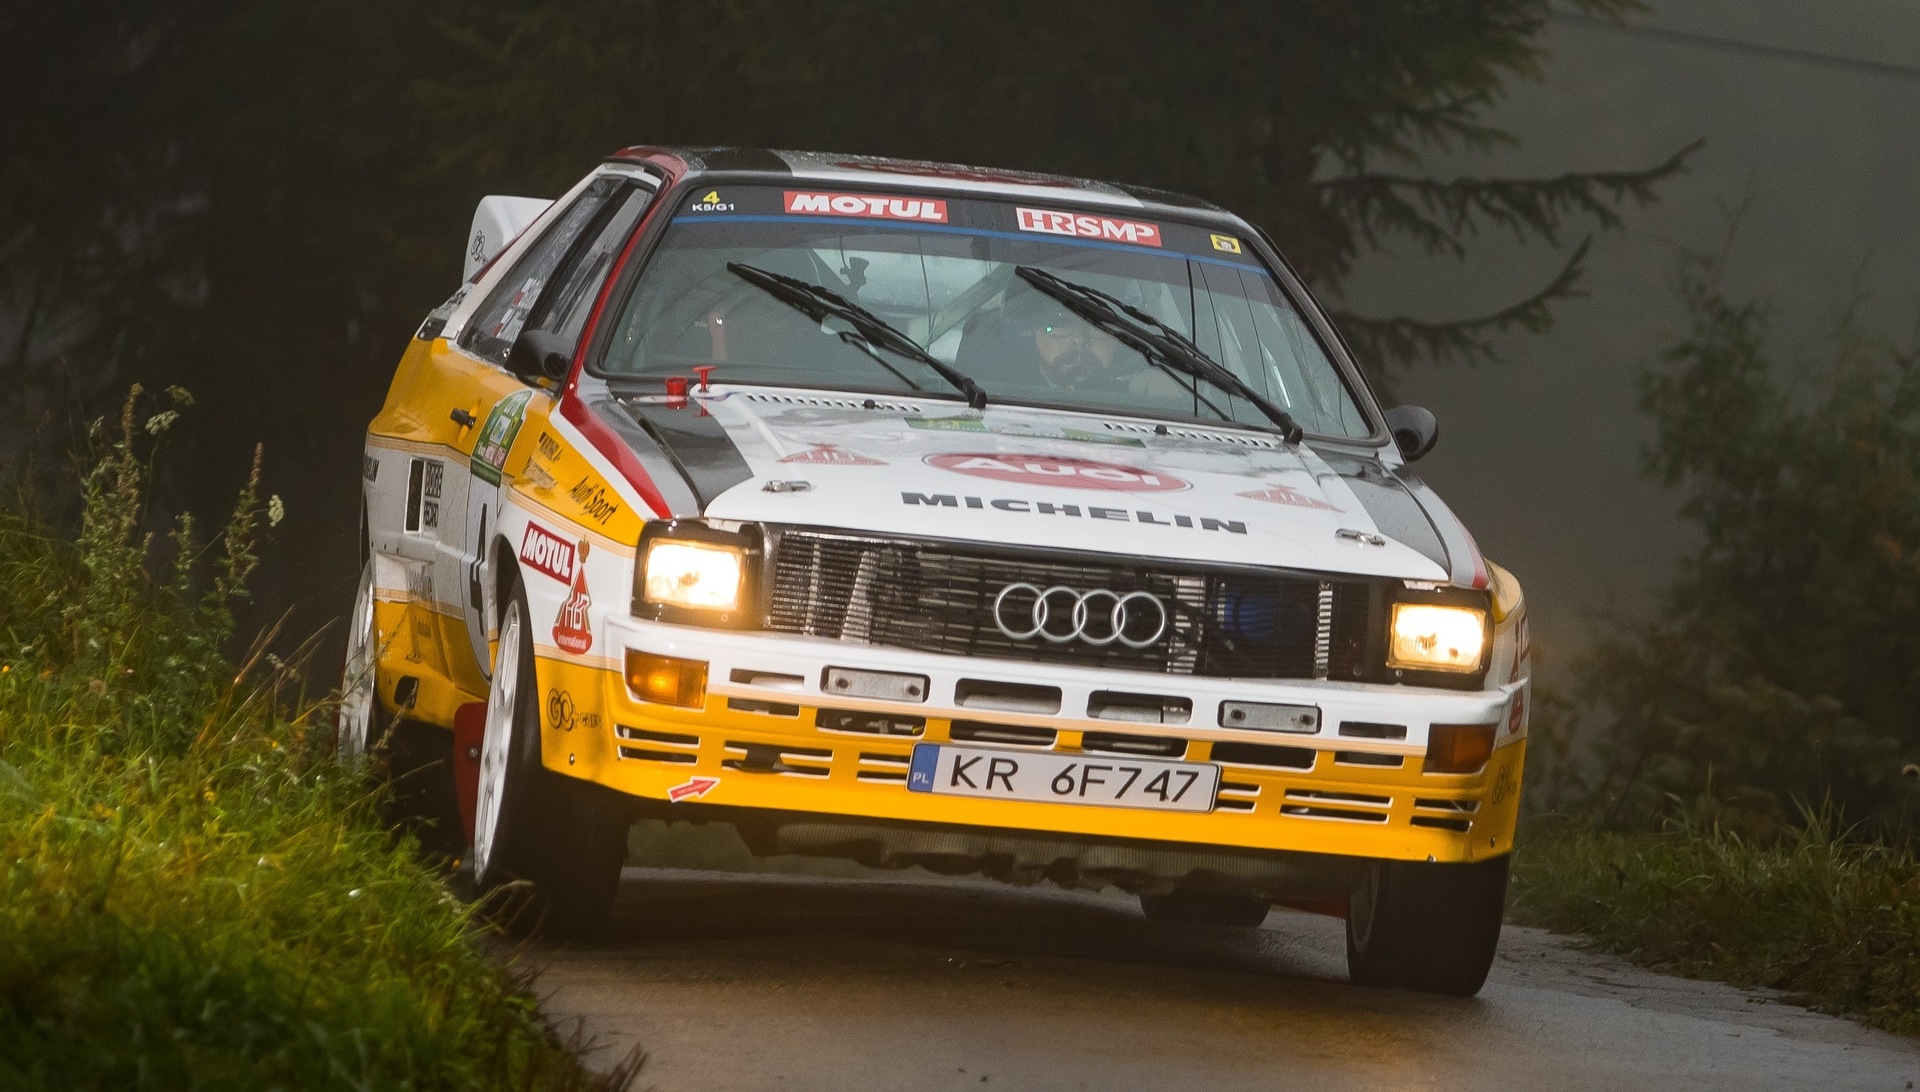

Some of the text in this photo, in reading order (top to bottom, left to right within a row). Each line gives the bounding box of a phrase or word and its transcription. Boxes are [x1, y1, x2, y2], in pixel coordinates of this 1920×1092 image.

[692, 202, 735, 212] K5/G1
[703, 191, 720, 203] 4
[790, 194, 942, 220] MOTUL
[1020, 209, 1155, 242] HRSMP
[566, 475, 619, 526] Audi Sport
[900, 492, 1248, 535] MICHELIN
[522, 527, 571, 579] MOTUL
[912, 771, 930, 785] PL
[950, 754, 1200, 802] KR 6F747
